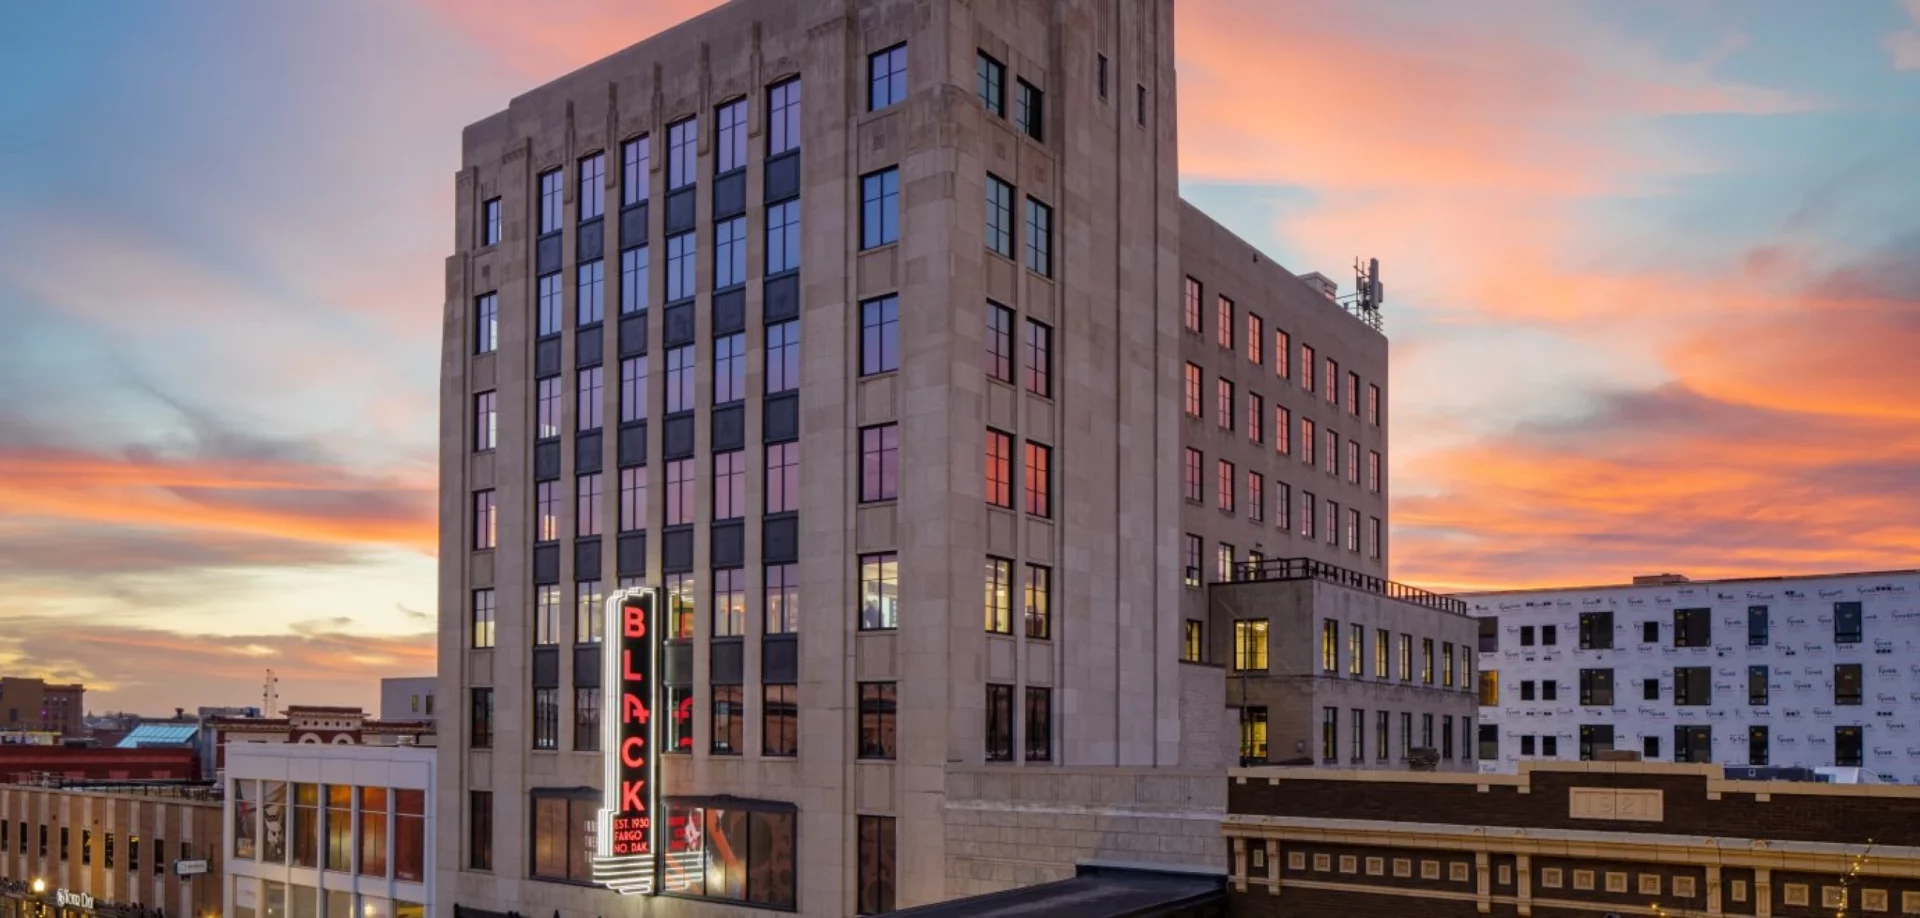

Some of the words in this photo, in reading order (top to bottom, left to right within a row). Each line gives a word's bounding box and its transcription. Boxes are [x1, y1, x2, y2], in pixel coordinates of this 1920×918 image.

[622, 606, 650, 813] BLACK
[614, 818, 630, 830] EST.
[632, 818, 649, 829] 1930
[615, 830, 643, 842] FARGO
